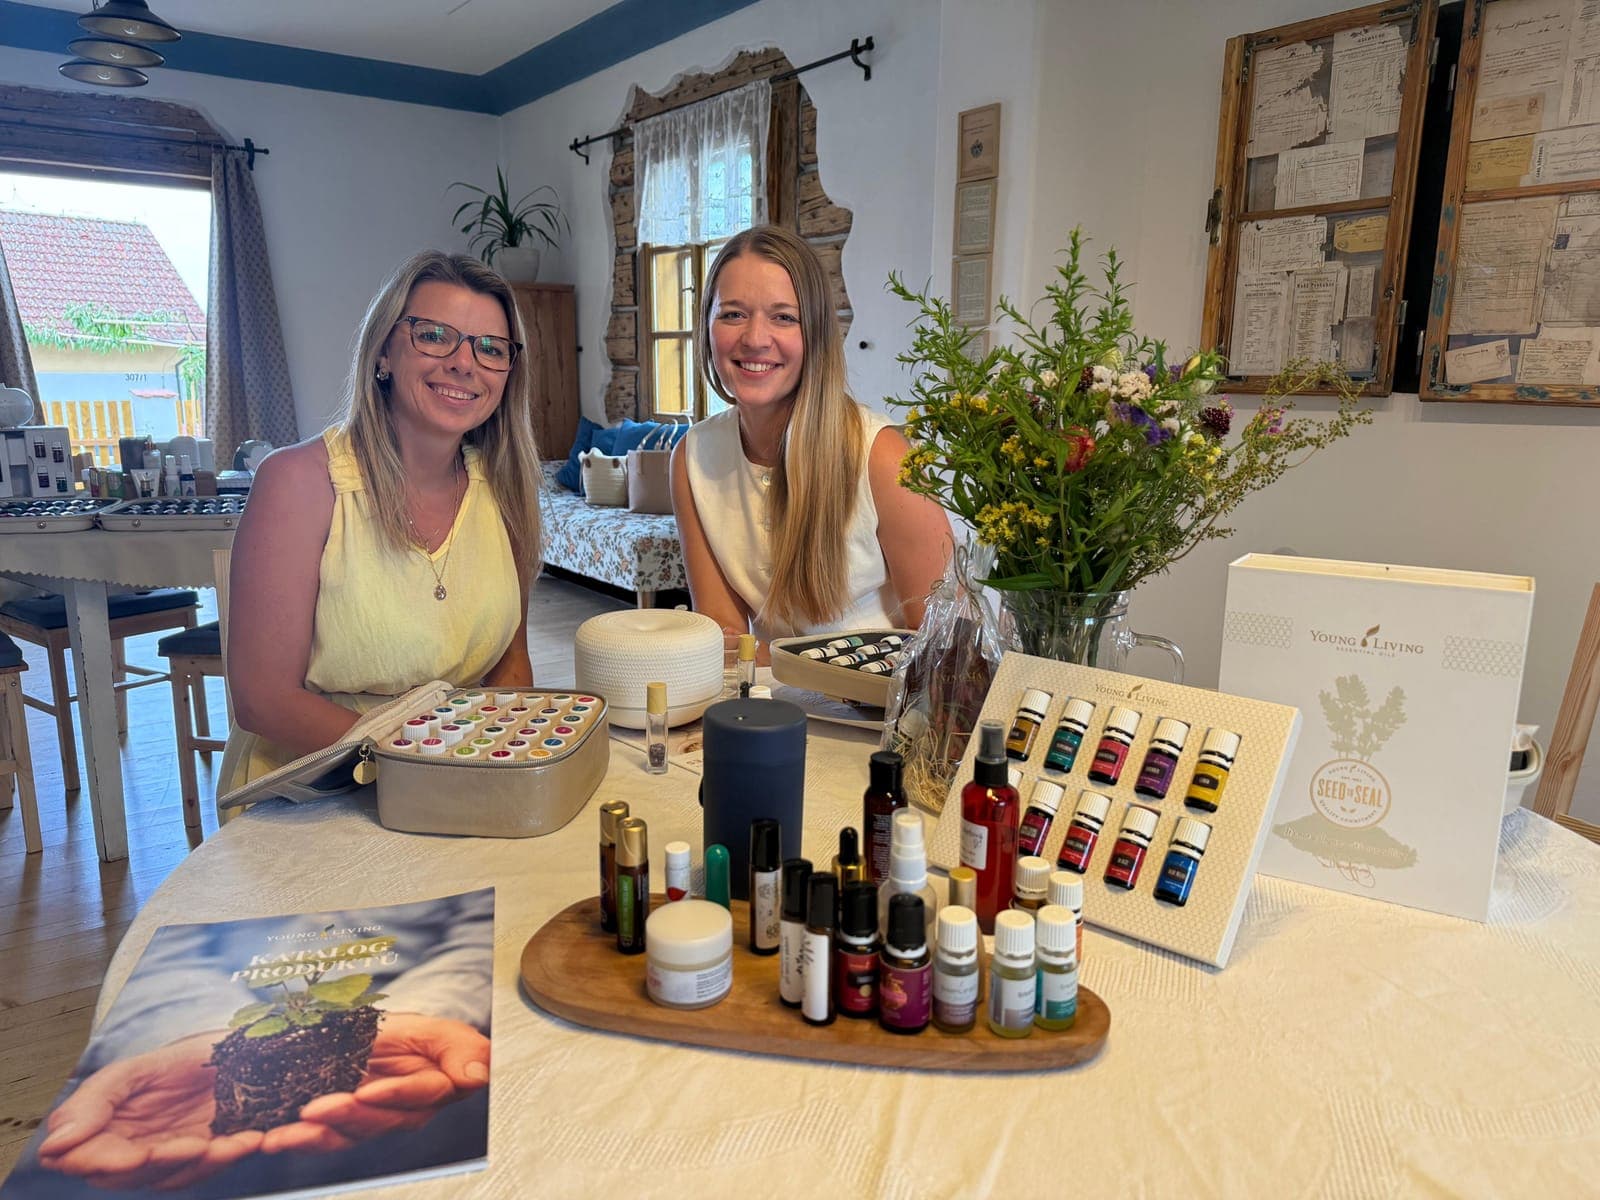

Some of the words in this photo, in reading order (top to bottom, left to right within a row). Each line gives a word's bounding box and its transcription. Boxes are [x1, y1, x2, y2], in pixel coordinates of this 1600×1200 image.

[1310, 629, 1356, 646] YOUNG
[1373, 637, 1424, 654] LIVING
[1096, 683, 1125, 697] YOUNG
[1135, 692, 1169, 707] LIVING
[1317, 778, 1347, 800] SEED
[1354, 784, 1383, 808] SEAL
[266, 931, 317, 942] YOUNG
[332, 924, 382, 936] LIVING
[249, 941, 393, 966] KATALOG
[230, 950, 400, 983] PRODUKTŮ
